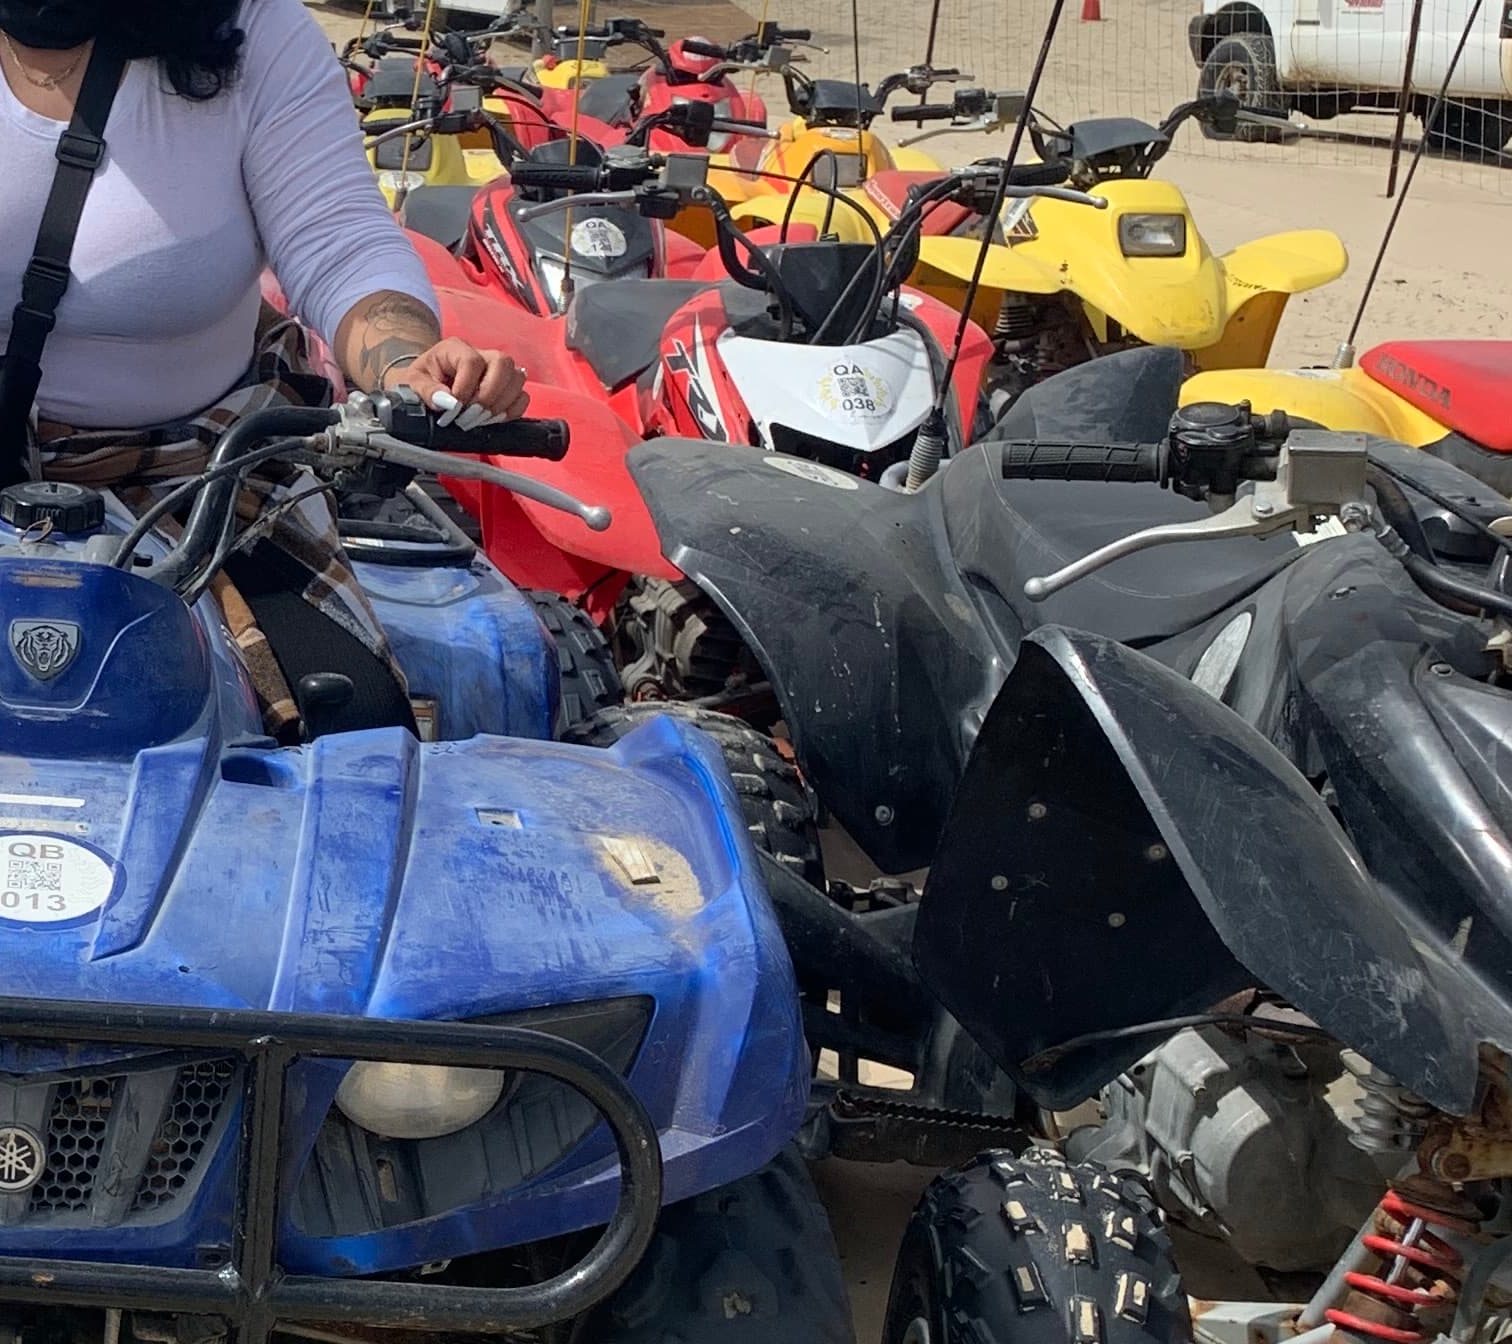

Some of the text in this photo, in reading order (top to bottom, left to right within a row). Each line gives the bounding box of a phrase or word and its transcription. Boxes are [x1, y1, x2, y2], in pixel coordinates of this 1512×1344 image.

[833, 364, 865, 376] QA
[1376, 352, 1452, 410] HONDA
[842, 397, 876, 412] 038
[8, 842, 65, 860] QB
[0, 891, 66, 912] 013
